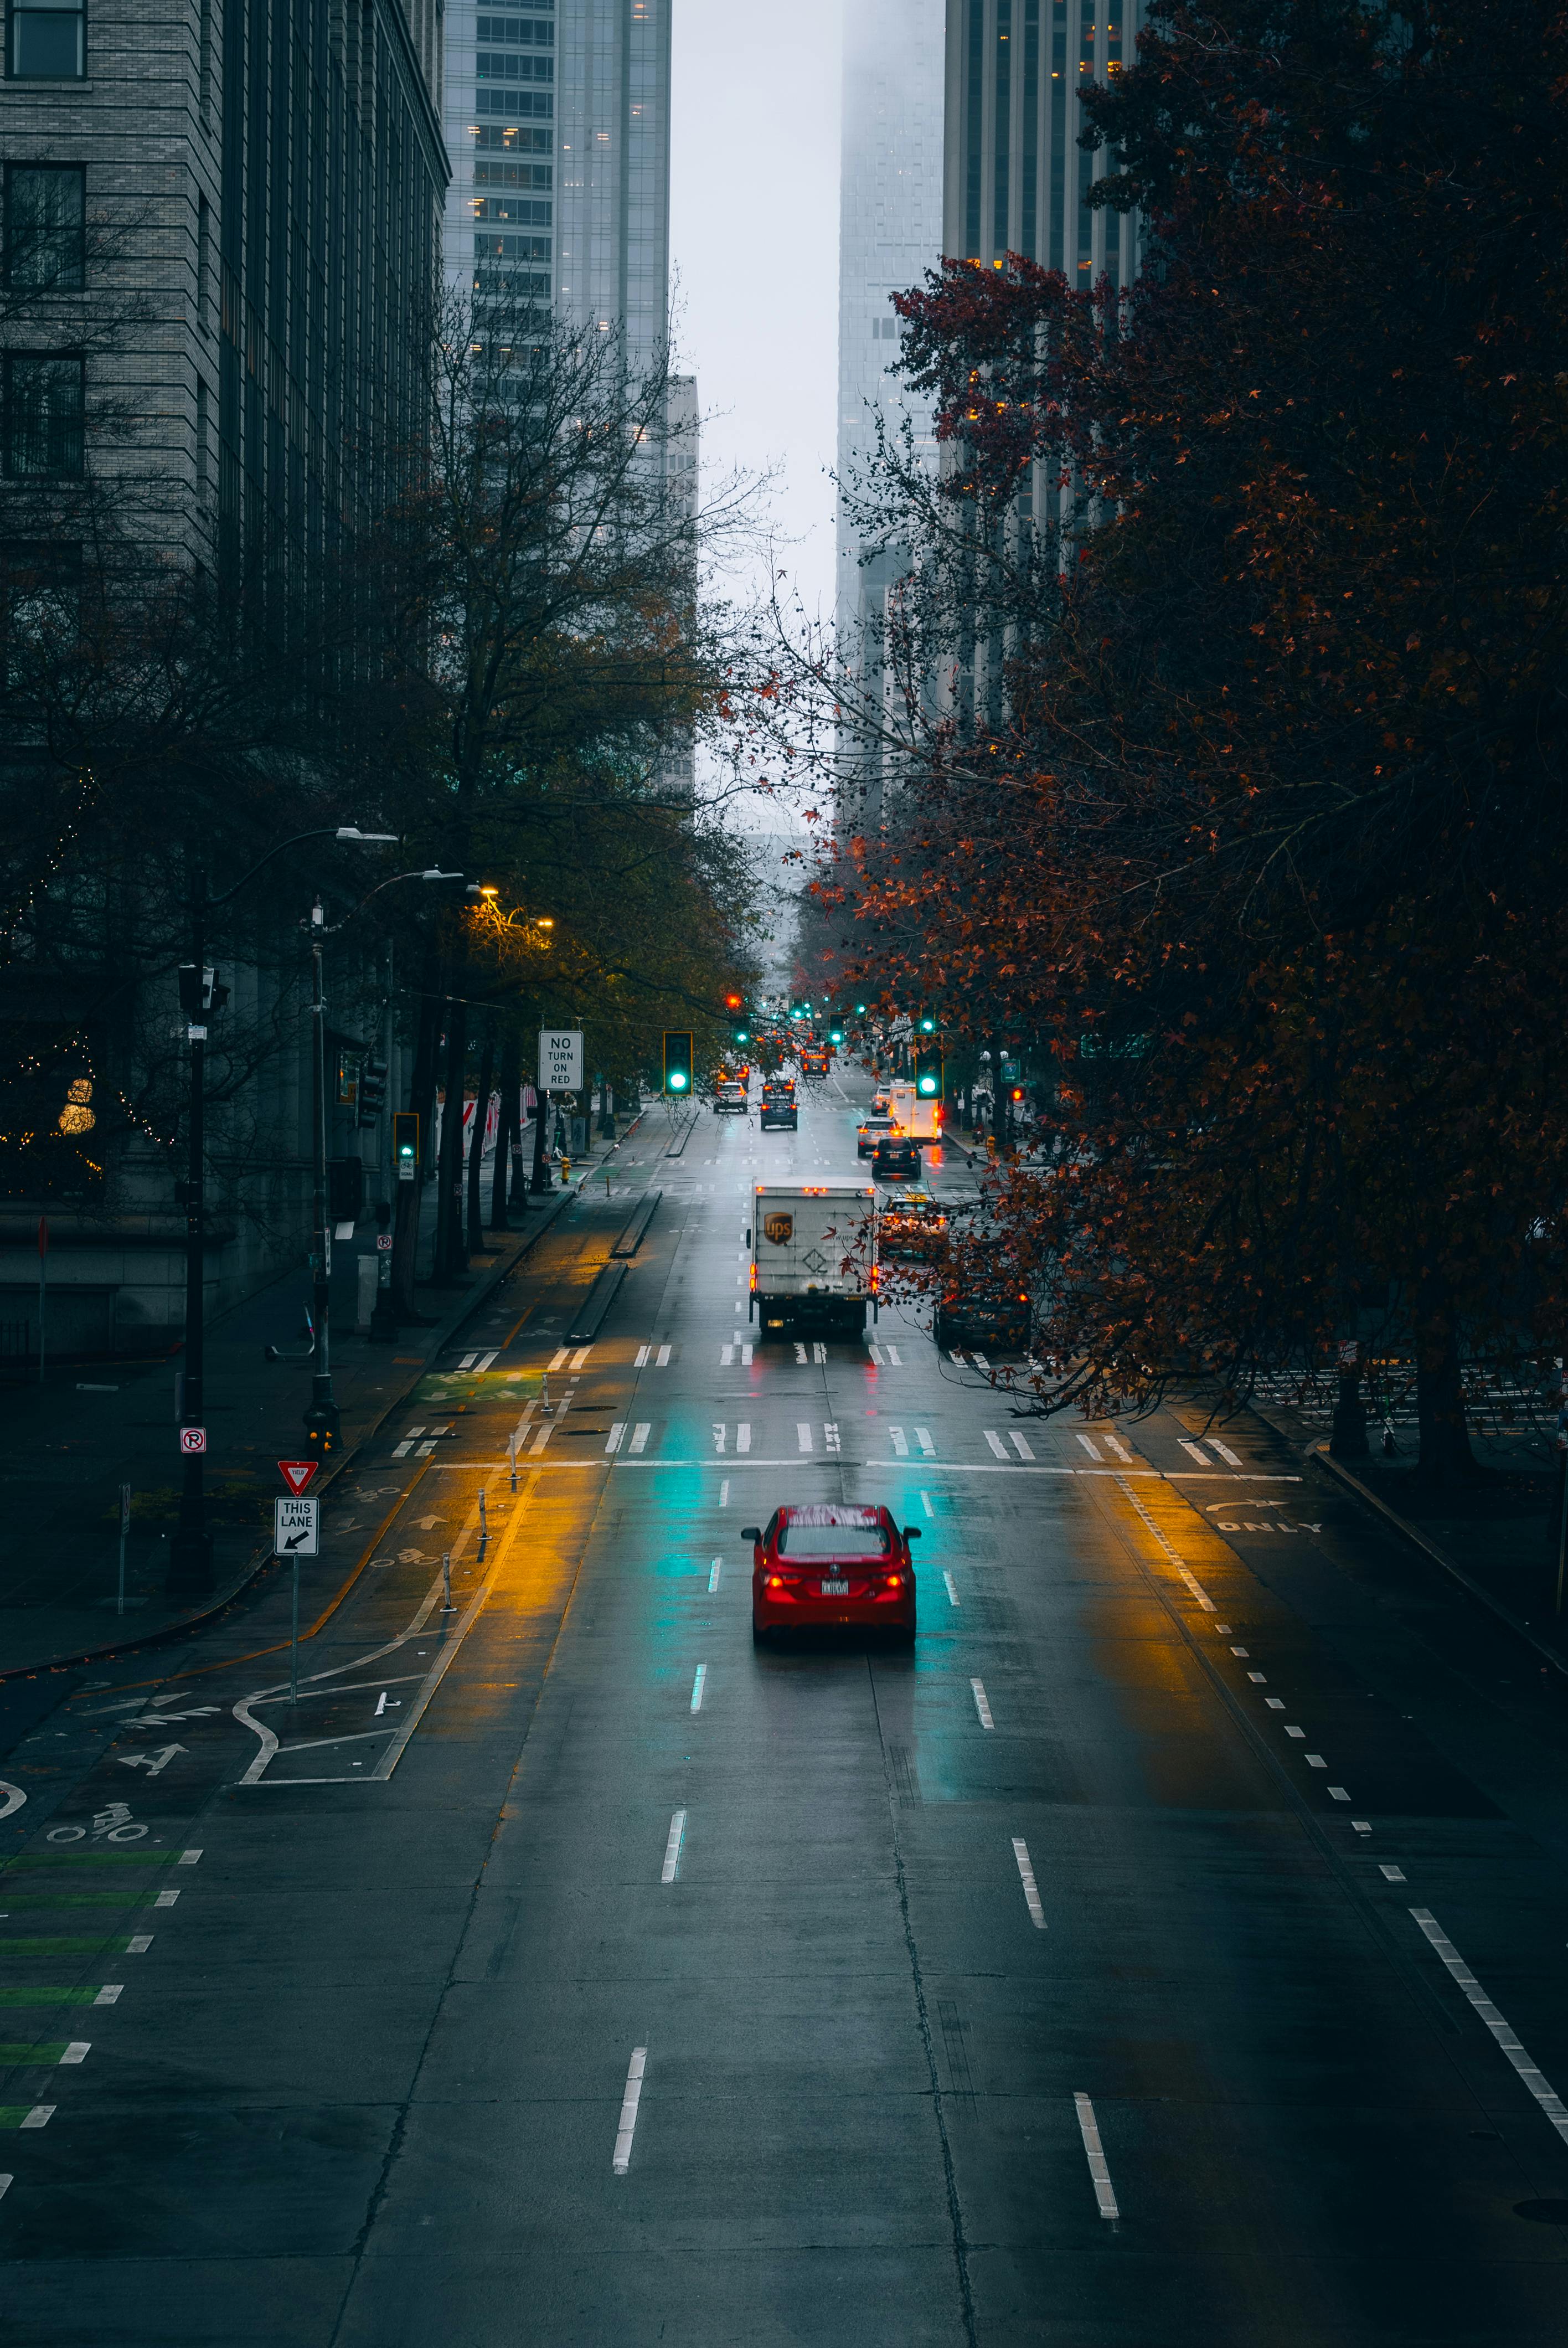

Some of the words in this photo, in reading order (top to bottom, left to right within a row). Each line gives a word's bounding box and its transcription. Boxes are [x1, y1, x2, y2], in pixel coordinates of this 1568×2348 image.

[551, 1038, 571, 1049] NO
[548, 1052, 573, 1060] TURN
[766, 1222, 791, 1240] ups
[284, 1503, 311, 1513] THIS
[281, 1516, 312, 1527] LANE
[1217, 1522, 1322, 1533] ONLY
